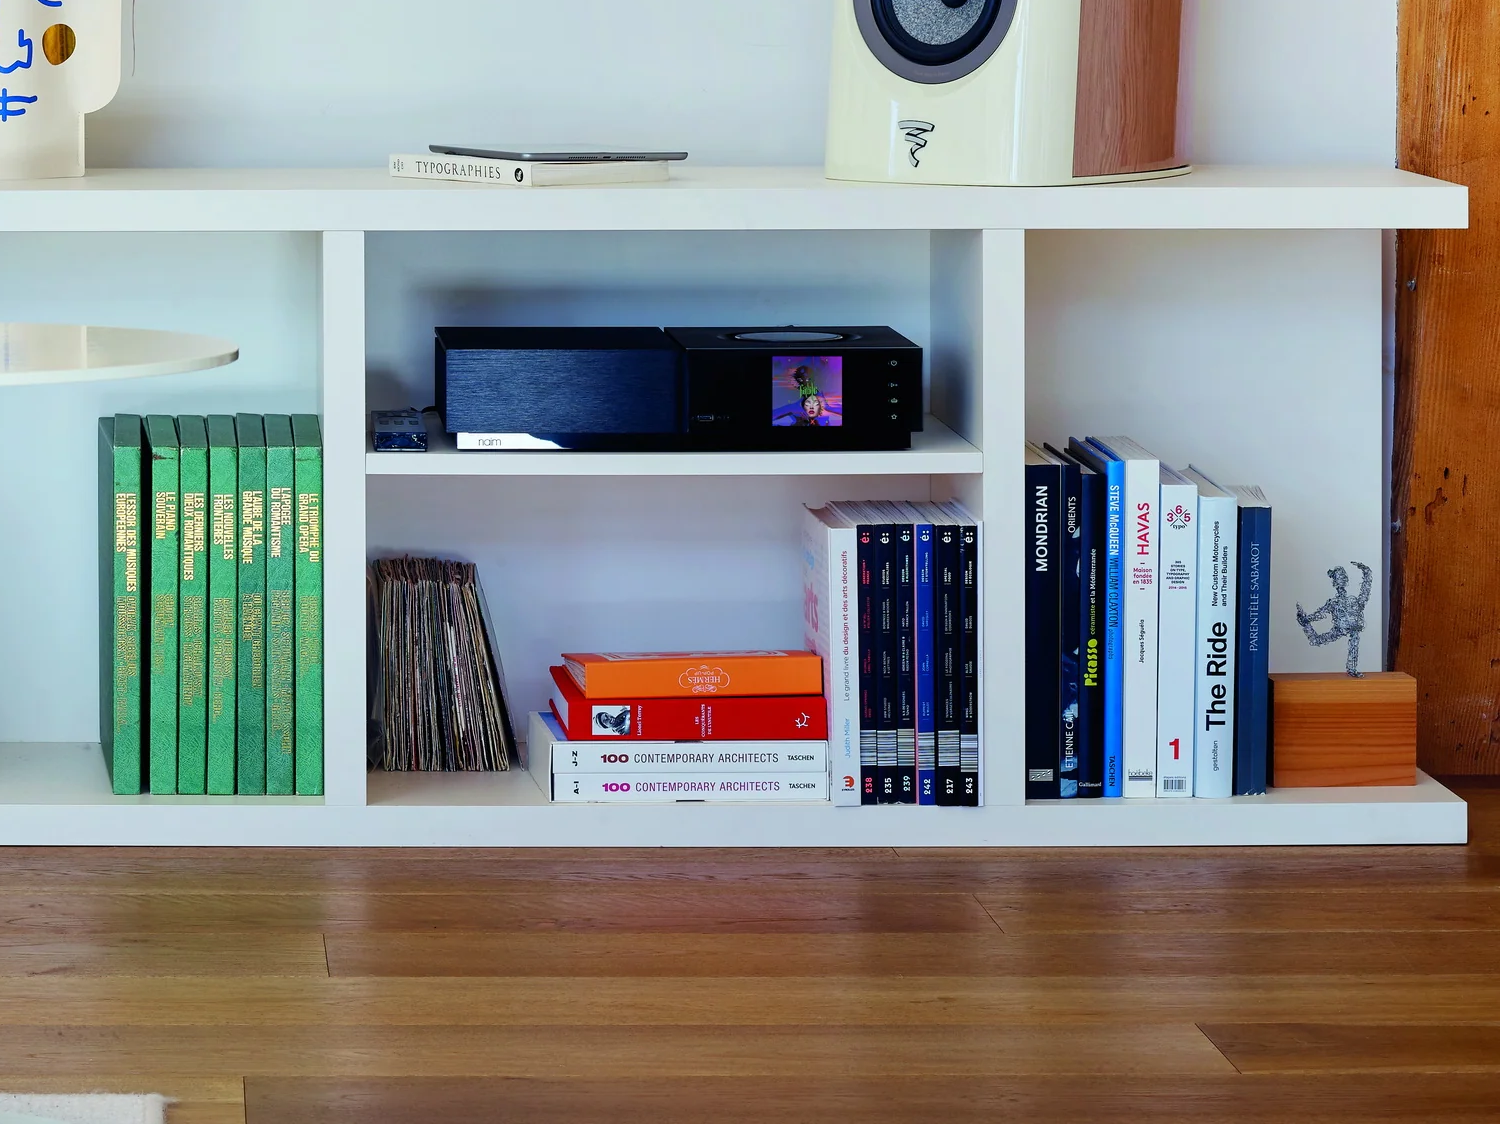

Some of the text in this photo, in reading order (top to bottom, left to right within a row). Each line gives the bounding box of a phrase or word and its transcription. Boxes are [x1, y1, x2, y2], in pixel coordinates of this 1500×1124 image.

[415, 160, 501, 180] TYPOGRAPHIES
[478, 438, 502, 446] naim
[156, 492, 166, 539] SOUVERAIN
[166, 492, 176, 530] LE PIANO
[1068, 496, 1076, 533] ORIENTS
[1110, 485, 1119, 511] STEVE
[183, 493, 194, 580] DIEUX ROMANTIQUES
[194, 493, 204, 551] LES DERNIERS
[214, 494, 223, 545] FRONTIERES
[224, 494, 234, 560] LES NOUVELLES
[241, 491, 252, 564] GRANDE MUSIQUE
[252, 491, 262, 545] L'AUBE DE LA
[271, 488, 280, 558] DU ROMANTISME
[299, 493, 310, 553] GRAND OPERA
[309, 493, 319, 562] LE TRIOMPHE DU
[900, 531, 910, 542] é:
[920, 531, 929, 541] é:
[1035, 486, 1048, 571] MONDRIAN
[1109, 515, 1119, 556] McQUEEN
[1137, 503, 1150, 555] HAVAS
[125, 493, 136, 592] L'ESSOR DES MUSIQUES
[860, 532, 870, 543] é:
[880, 533, 889, 544] é:
[942, 532, 951, 543] é:
[964, 532, 973, 543] é:
[1109, 557, 1118, 590] WILLIAM
[1108, 592, 1118, 628] CLAXTON
[1248, 542, 1260, 651] PARENTÈLE SABAROT
[842, 623, 851, 645] design
[842, 646, 849, 655] du
[1084, 639, 1098, 686] Picasso
[1206, 622, 1228, 731] The Ride
[843, 672, 851, 691] grand
[843, 692, 849, 701] Le
[600, 754, 629, 763] 100
[634, 753, 714, 764] CONTEMPORARY
[718, 753, 778, 763] ARCHITECTS
[1065, 731, 1074, 768] ETIENNE
[1169, 738, 1179, 760] 1
[602, 783, 630, 792] 100
[635, 782, 716, 792] CONTEMPORARY
[720, 781, 780, 791] ARCHITECTS
